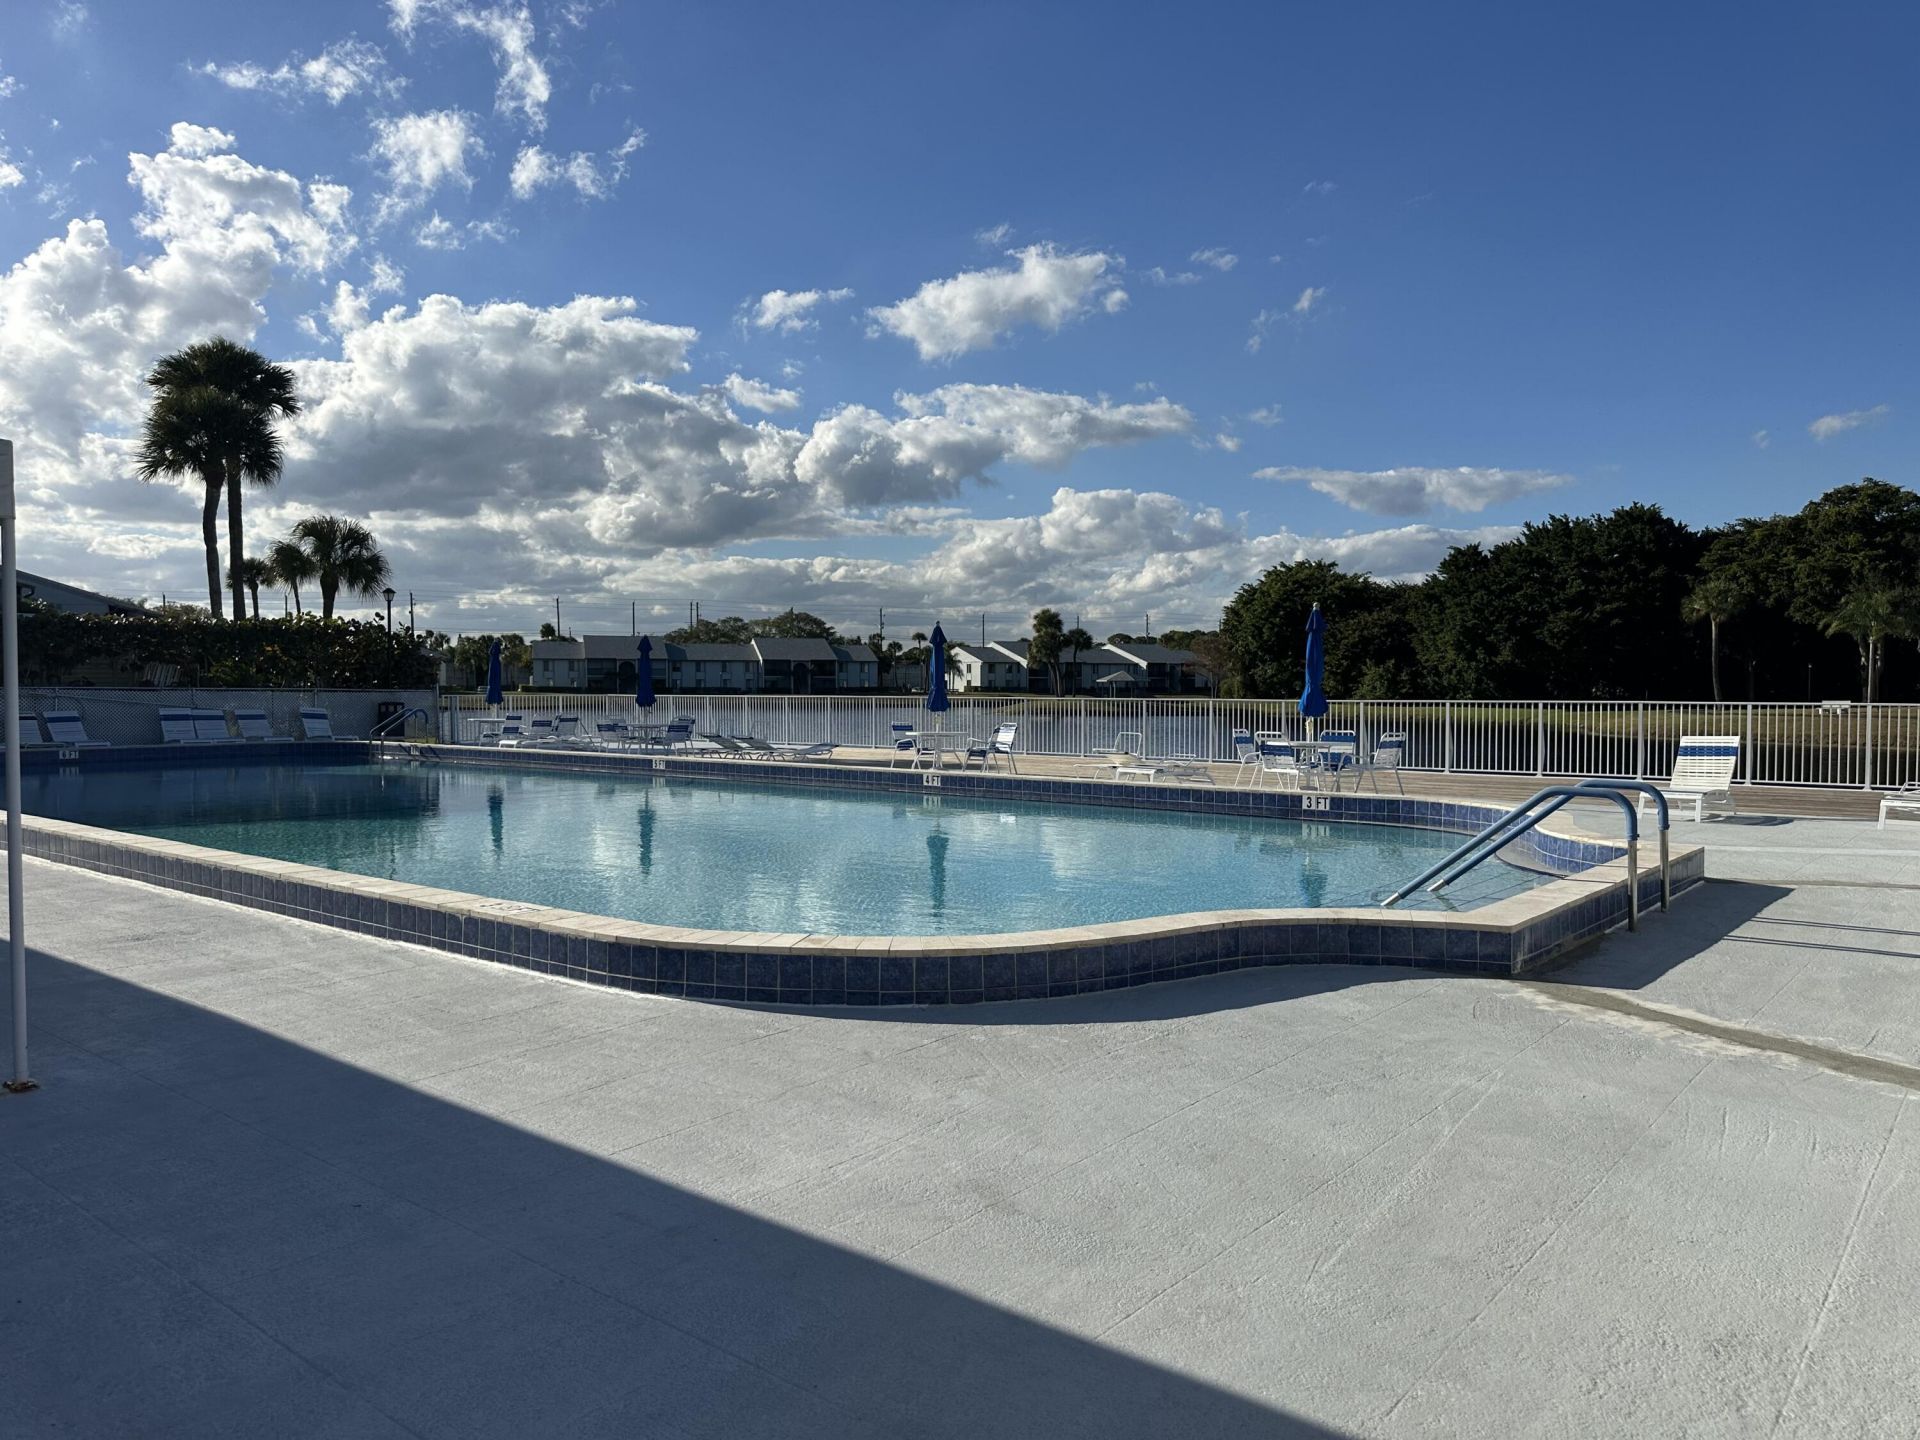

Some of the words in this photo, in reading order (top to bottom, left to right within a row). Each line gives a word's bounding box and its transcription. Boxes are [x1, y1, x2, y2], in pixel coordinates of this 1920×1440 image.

[932, 775, 940, 786] FT
[1306, 796, 1312, 809] 3
[1316, 796, 1329, 810] FT
